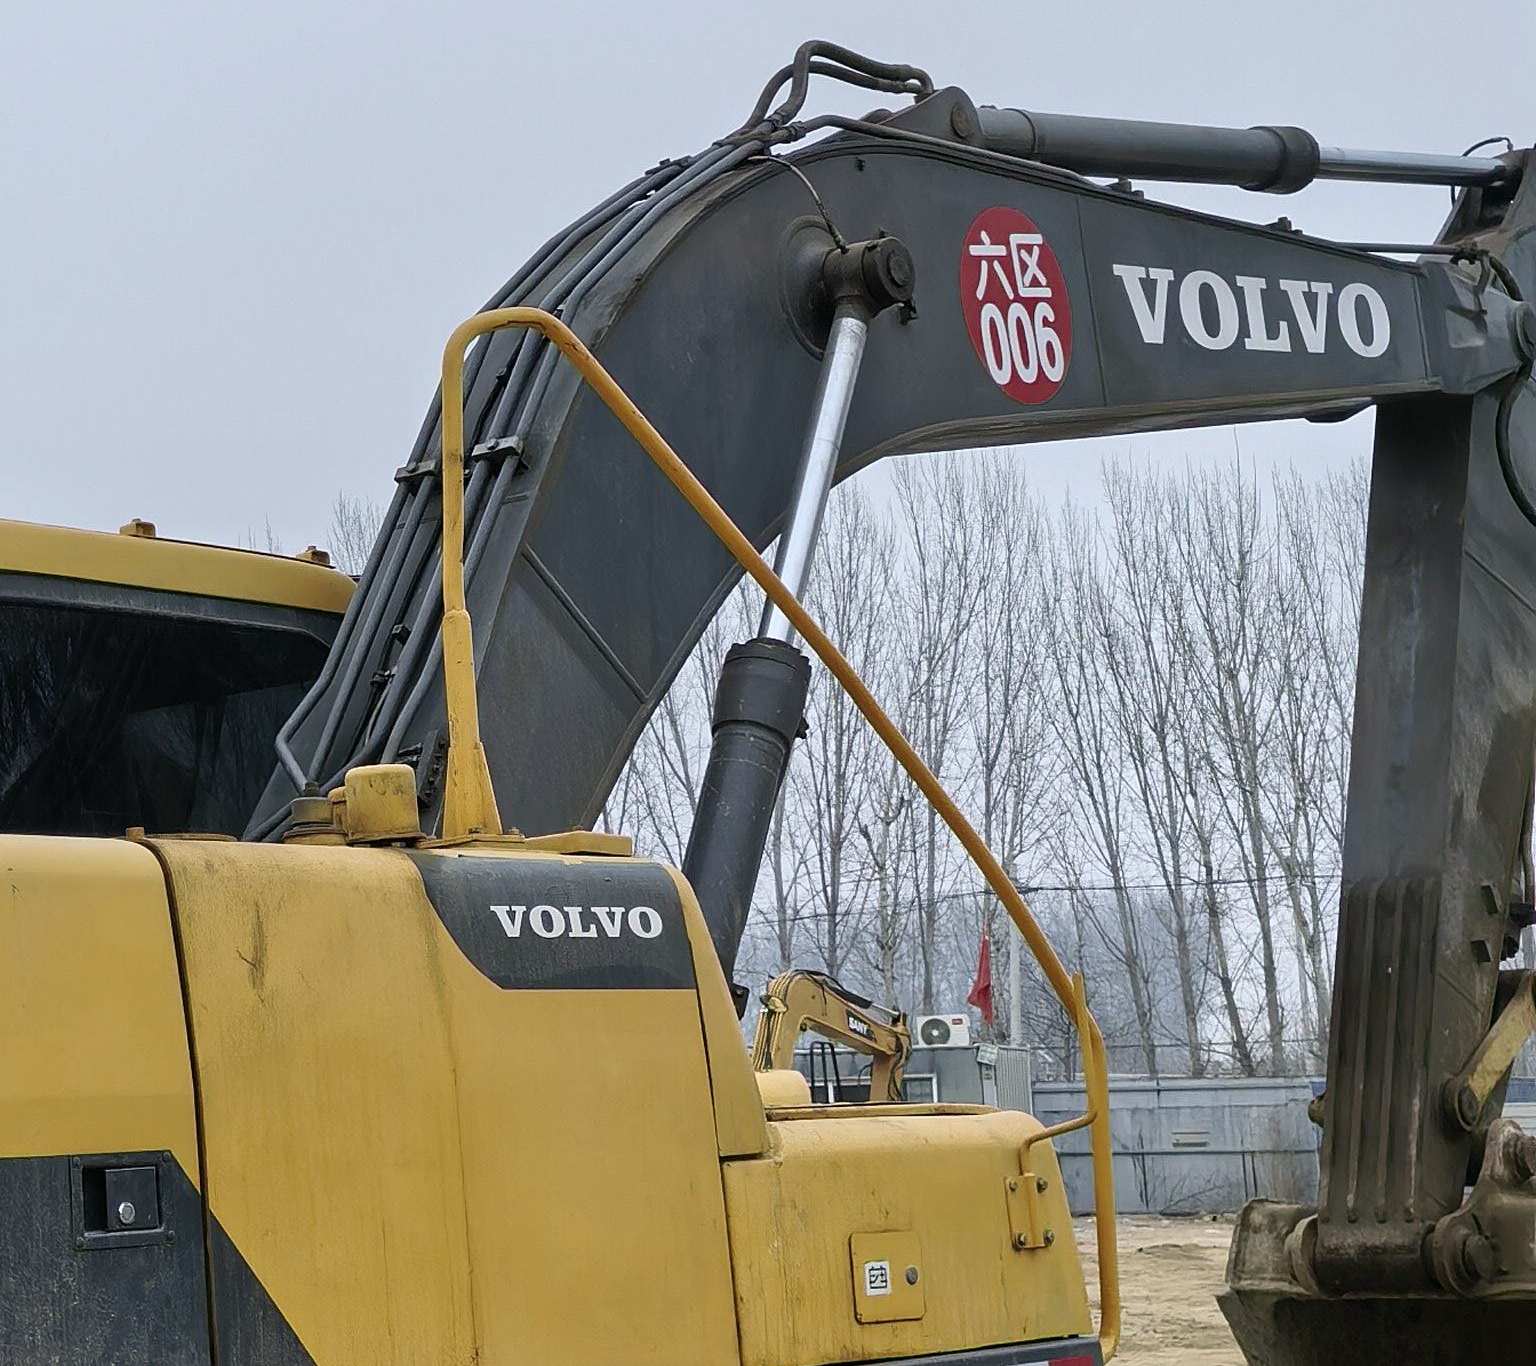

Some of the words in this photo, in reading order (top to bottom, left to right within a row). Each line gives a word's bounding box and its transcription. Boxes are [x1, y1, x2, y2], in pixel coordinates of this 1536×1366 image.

[969, 230, 1052, 301] 六区
[980, 302, 1064, 385] 006
[1112, 263, 1391, 359] VOLVO
[489, 905, 663, 939] VOLVO
